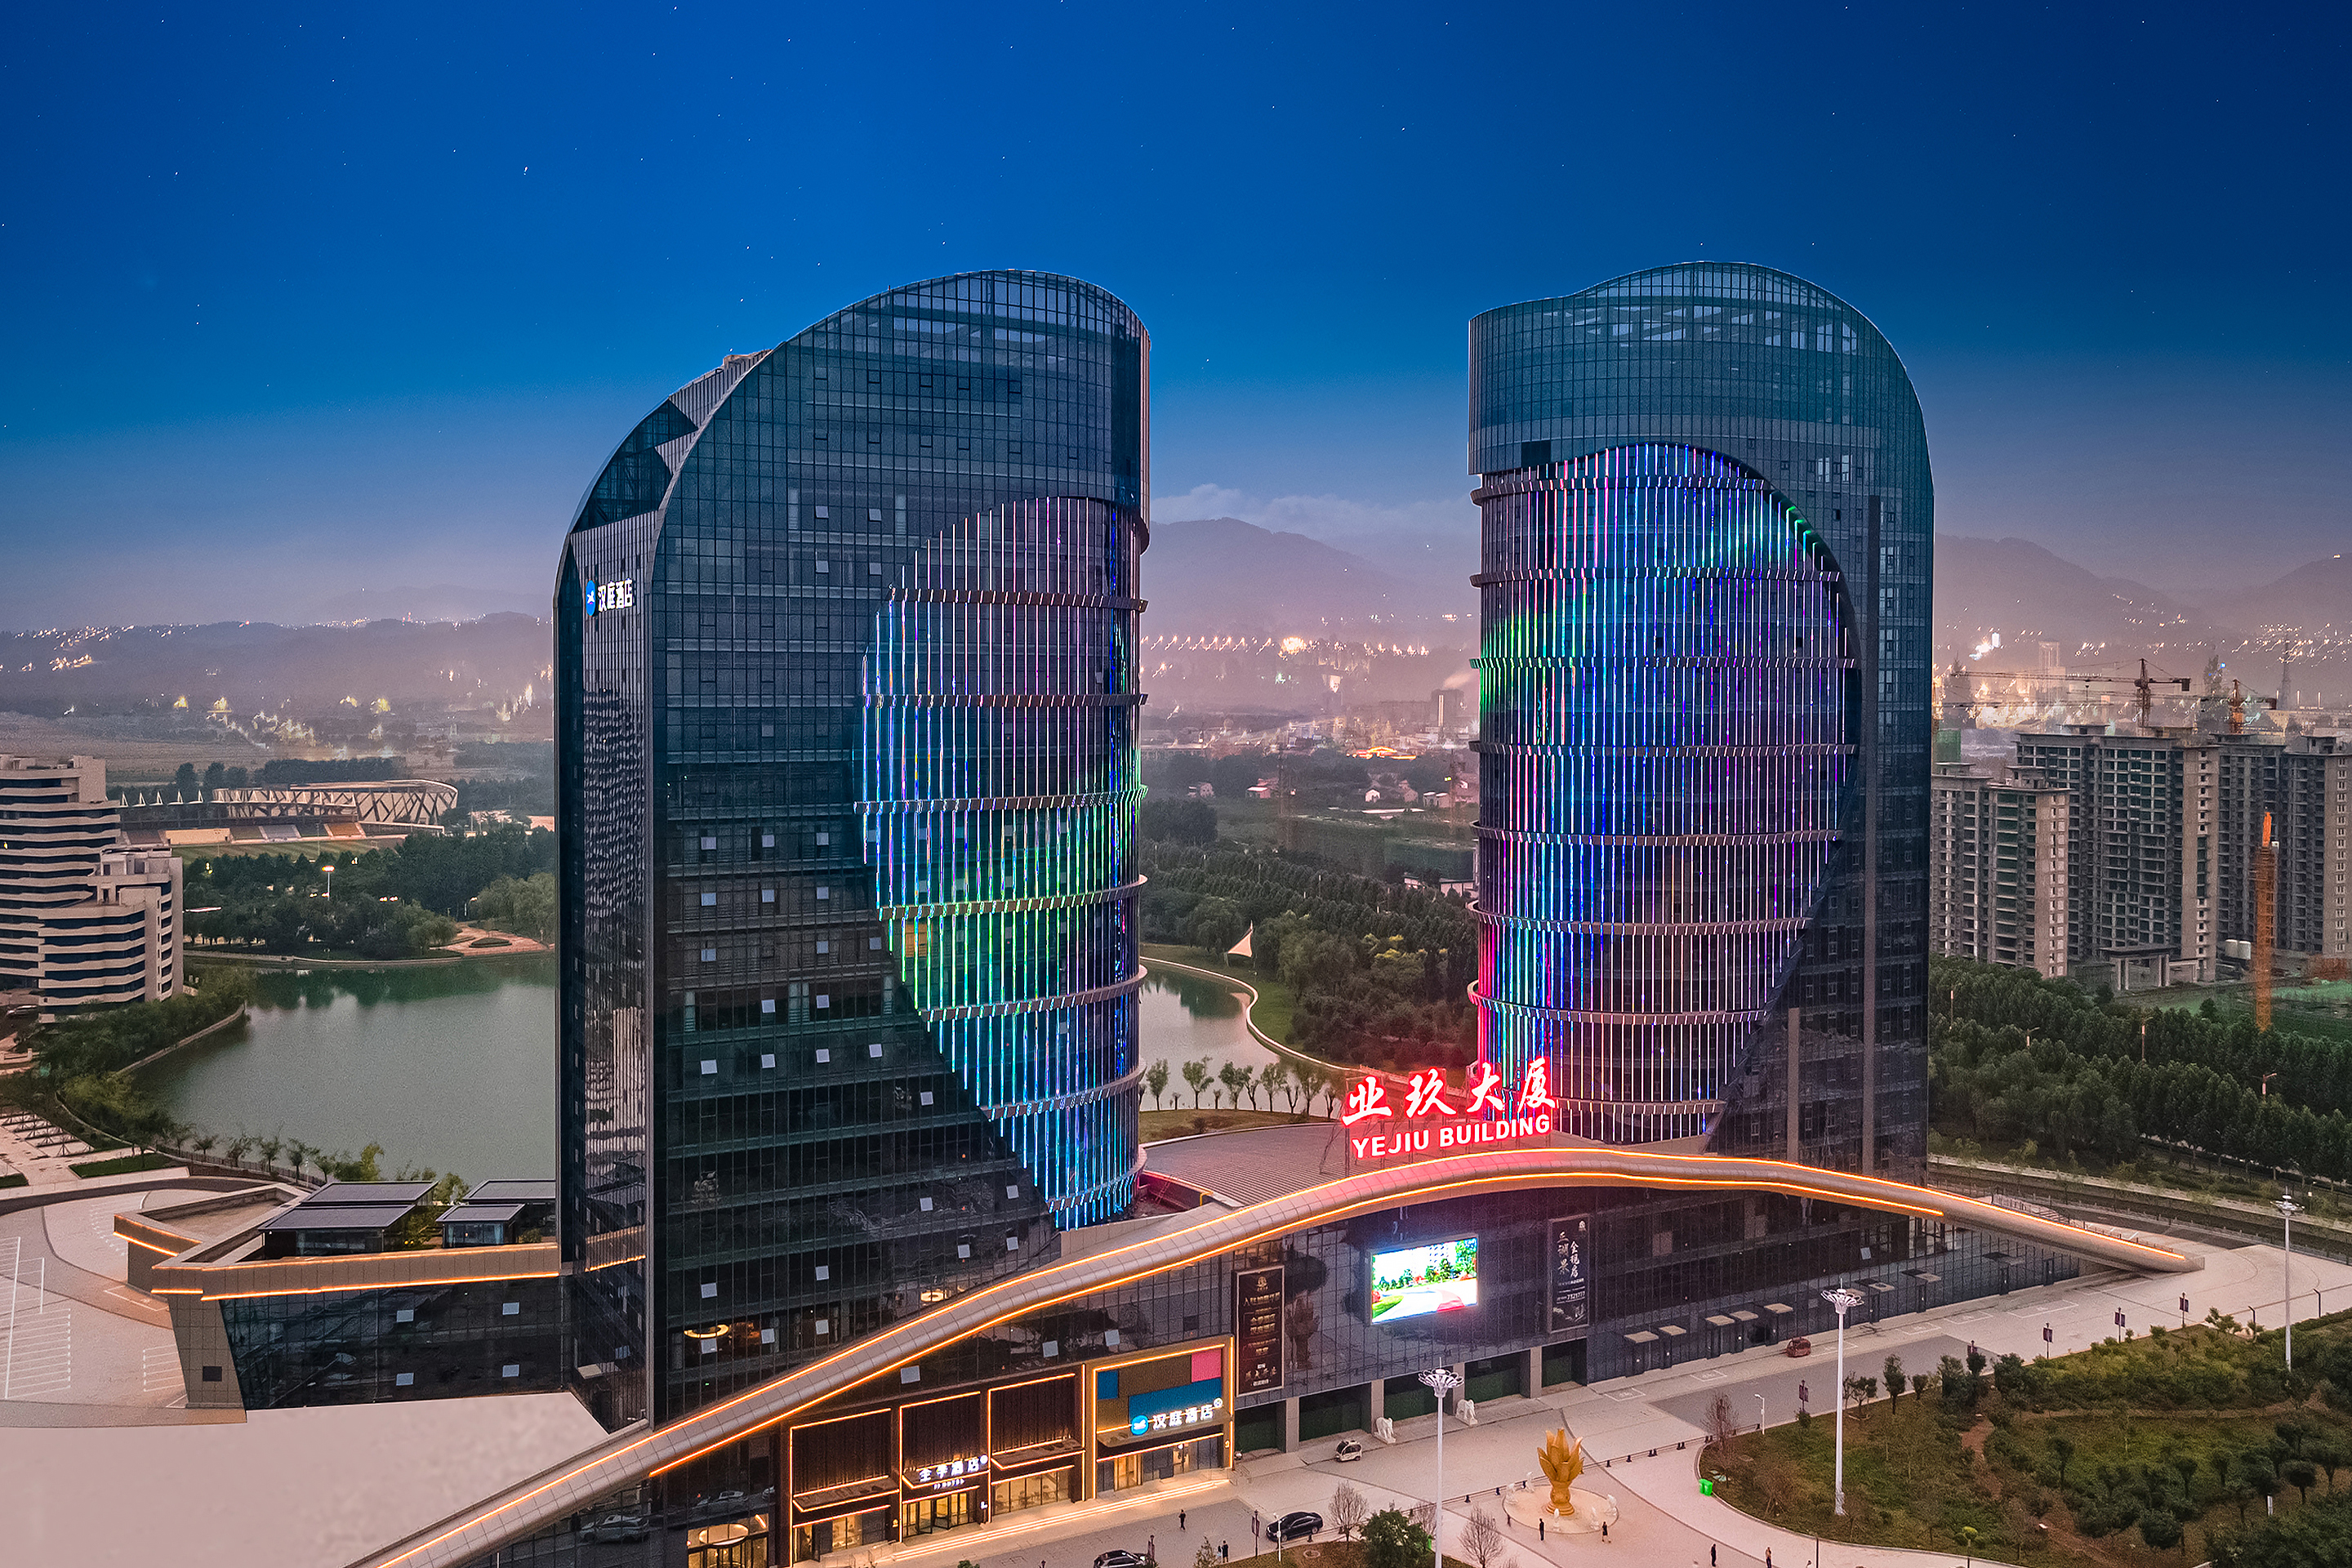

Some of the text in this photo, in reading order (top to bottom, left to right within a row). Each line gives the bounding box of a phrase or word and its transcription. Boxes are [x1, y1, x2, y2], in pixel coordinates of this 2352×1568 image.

[1342, 1057, 1556, 1126] 业玖大厦
[1352, 1114, 1550, 1158] YEJIU BUILDING
[1152, 1404, 1214, 1430] 汉庭酒店
